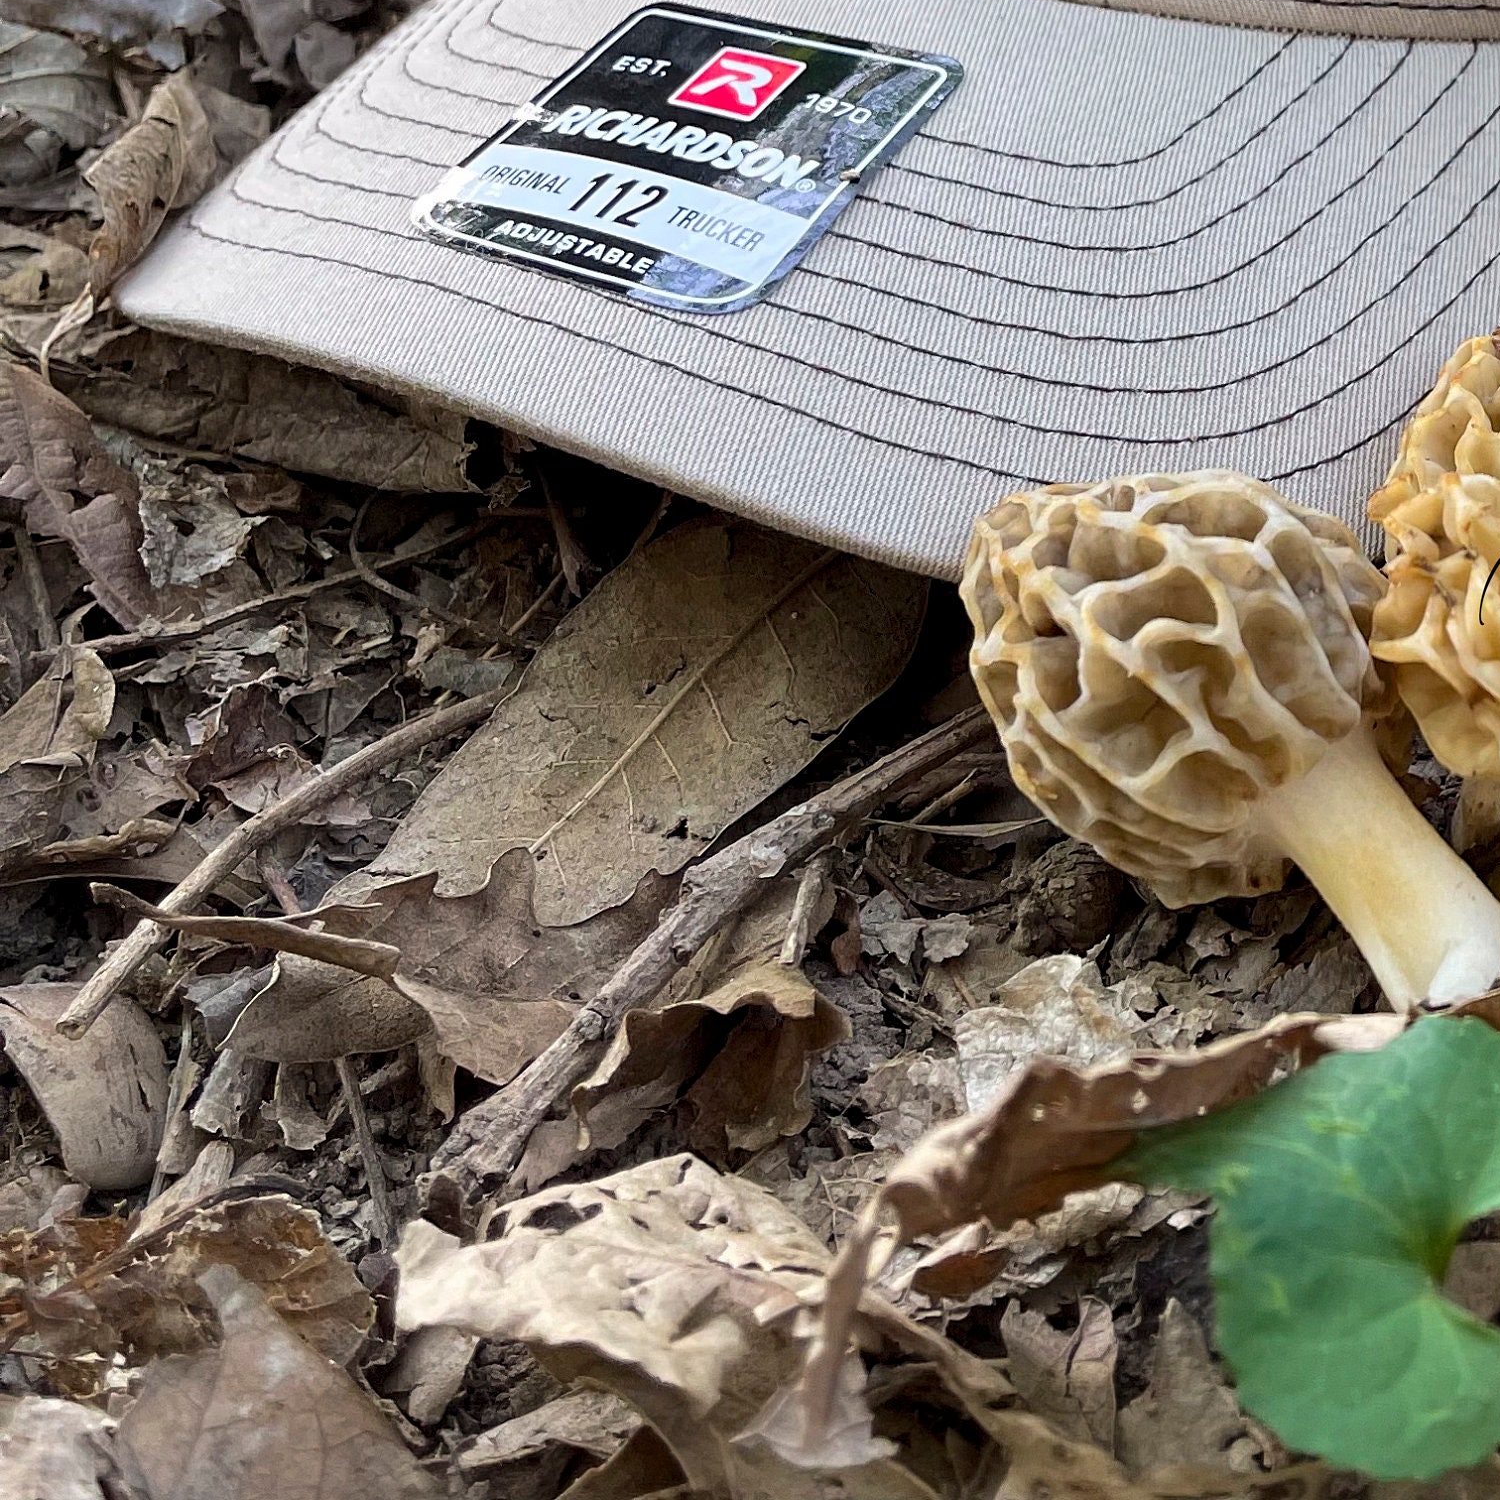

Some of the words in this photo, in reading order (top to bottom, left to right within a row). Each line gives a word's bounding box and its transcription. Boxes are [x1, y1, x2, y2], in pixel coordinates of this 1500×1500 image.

[611, 55, 671, 77] EST.
[804, 93, 872, 124] 1970
[542, 105, 819, 188] RICHARDSON
[480, 165, 571, 194] ORIGINAL
[567, 173, 668, 228] 112
[667, 206, 766, 252] TRUCKER
[487, 220, 654, 274] ADJUSTABLE
